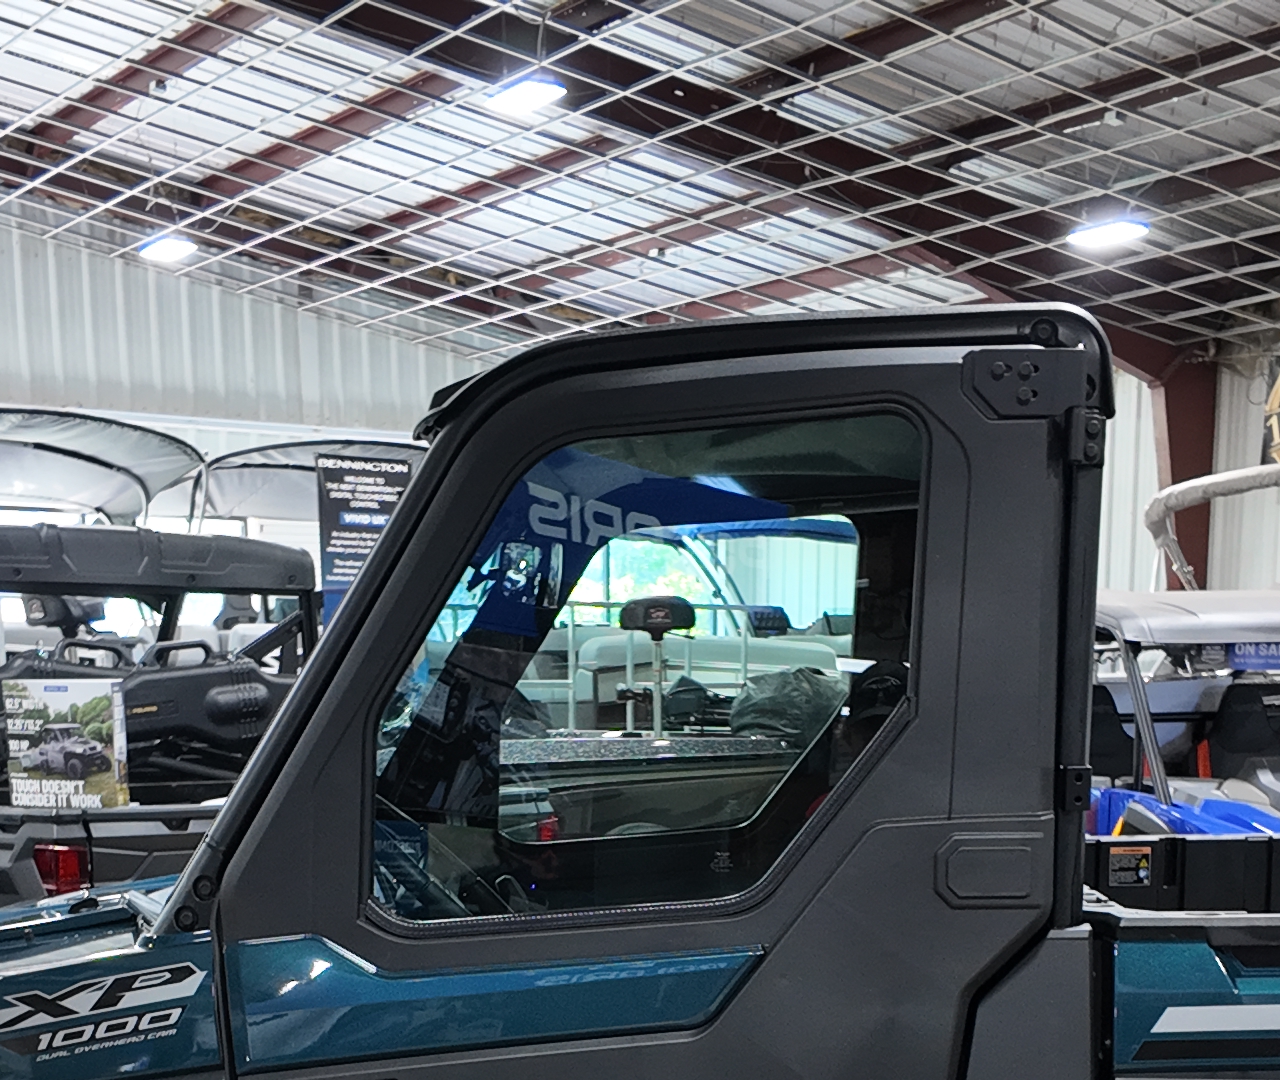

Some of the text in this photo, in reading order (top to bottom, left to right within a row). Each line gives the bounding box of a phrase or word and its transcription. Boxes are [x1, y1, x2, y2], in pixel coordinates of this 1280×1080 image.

[1234, 643, 1256, 656] ON
[12, 779, 84, 794] TOUGH DOESN'T
[12, 793, 102, 808] CONSIDER IT WORK
[37, 1007, 183, 1050] 1000
[36, 1028, 177, 1062] DUAL OVERHEAD CAM
